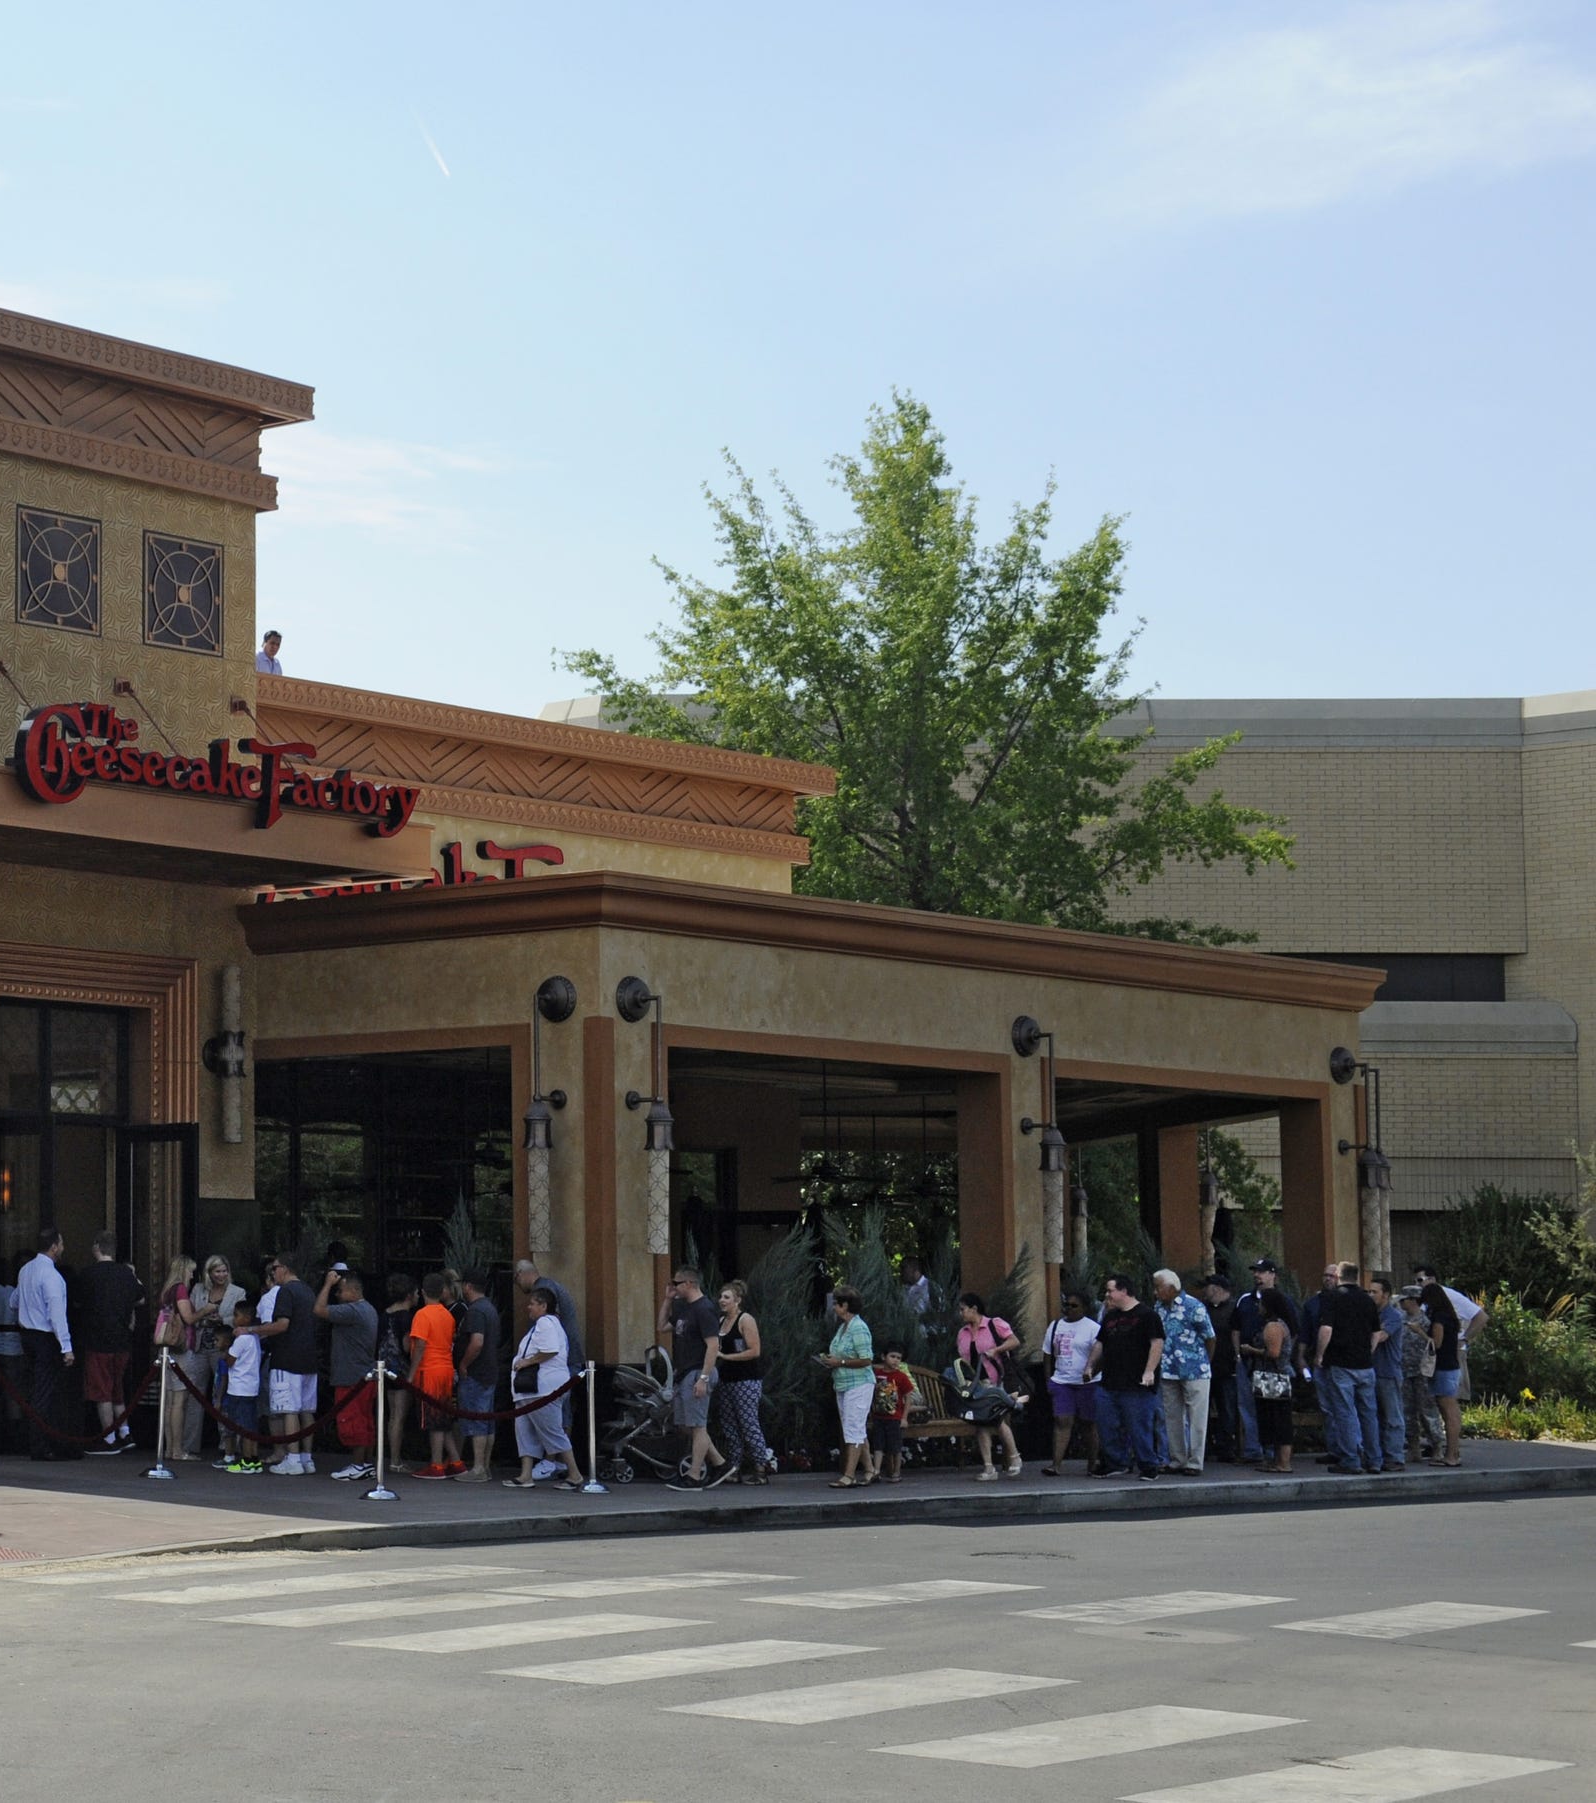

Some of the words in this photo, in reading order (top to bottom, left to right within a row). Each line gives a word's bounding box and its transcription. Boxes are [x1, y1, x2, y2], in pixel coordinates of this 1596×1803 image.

[83, 702, 139, 747] The
[22, 702, 263, 804] Cheesecake
[242, 737, 421, 838] Factory
